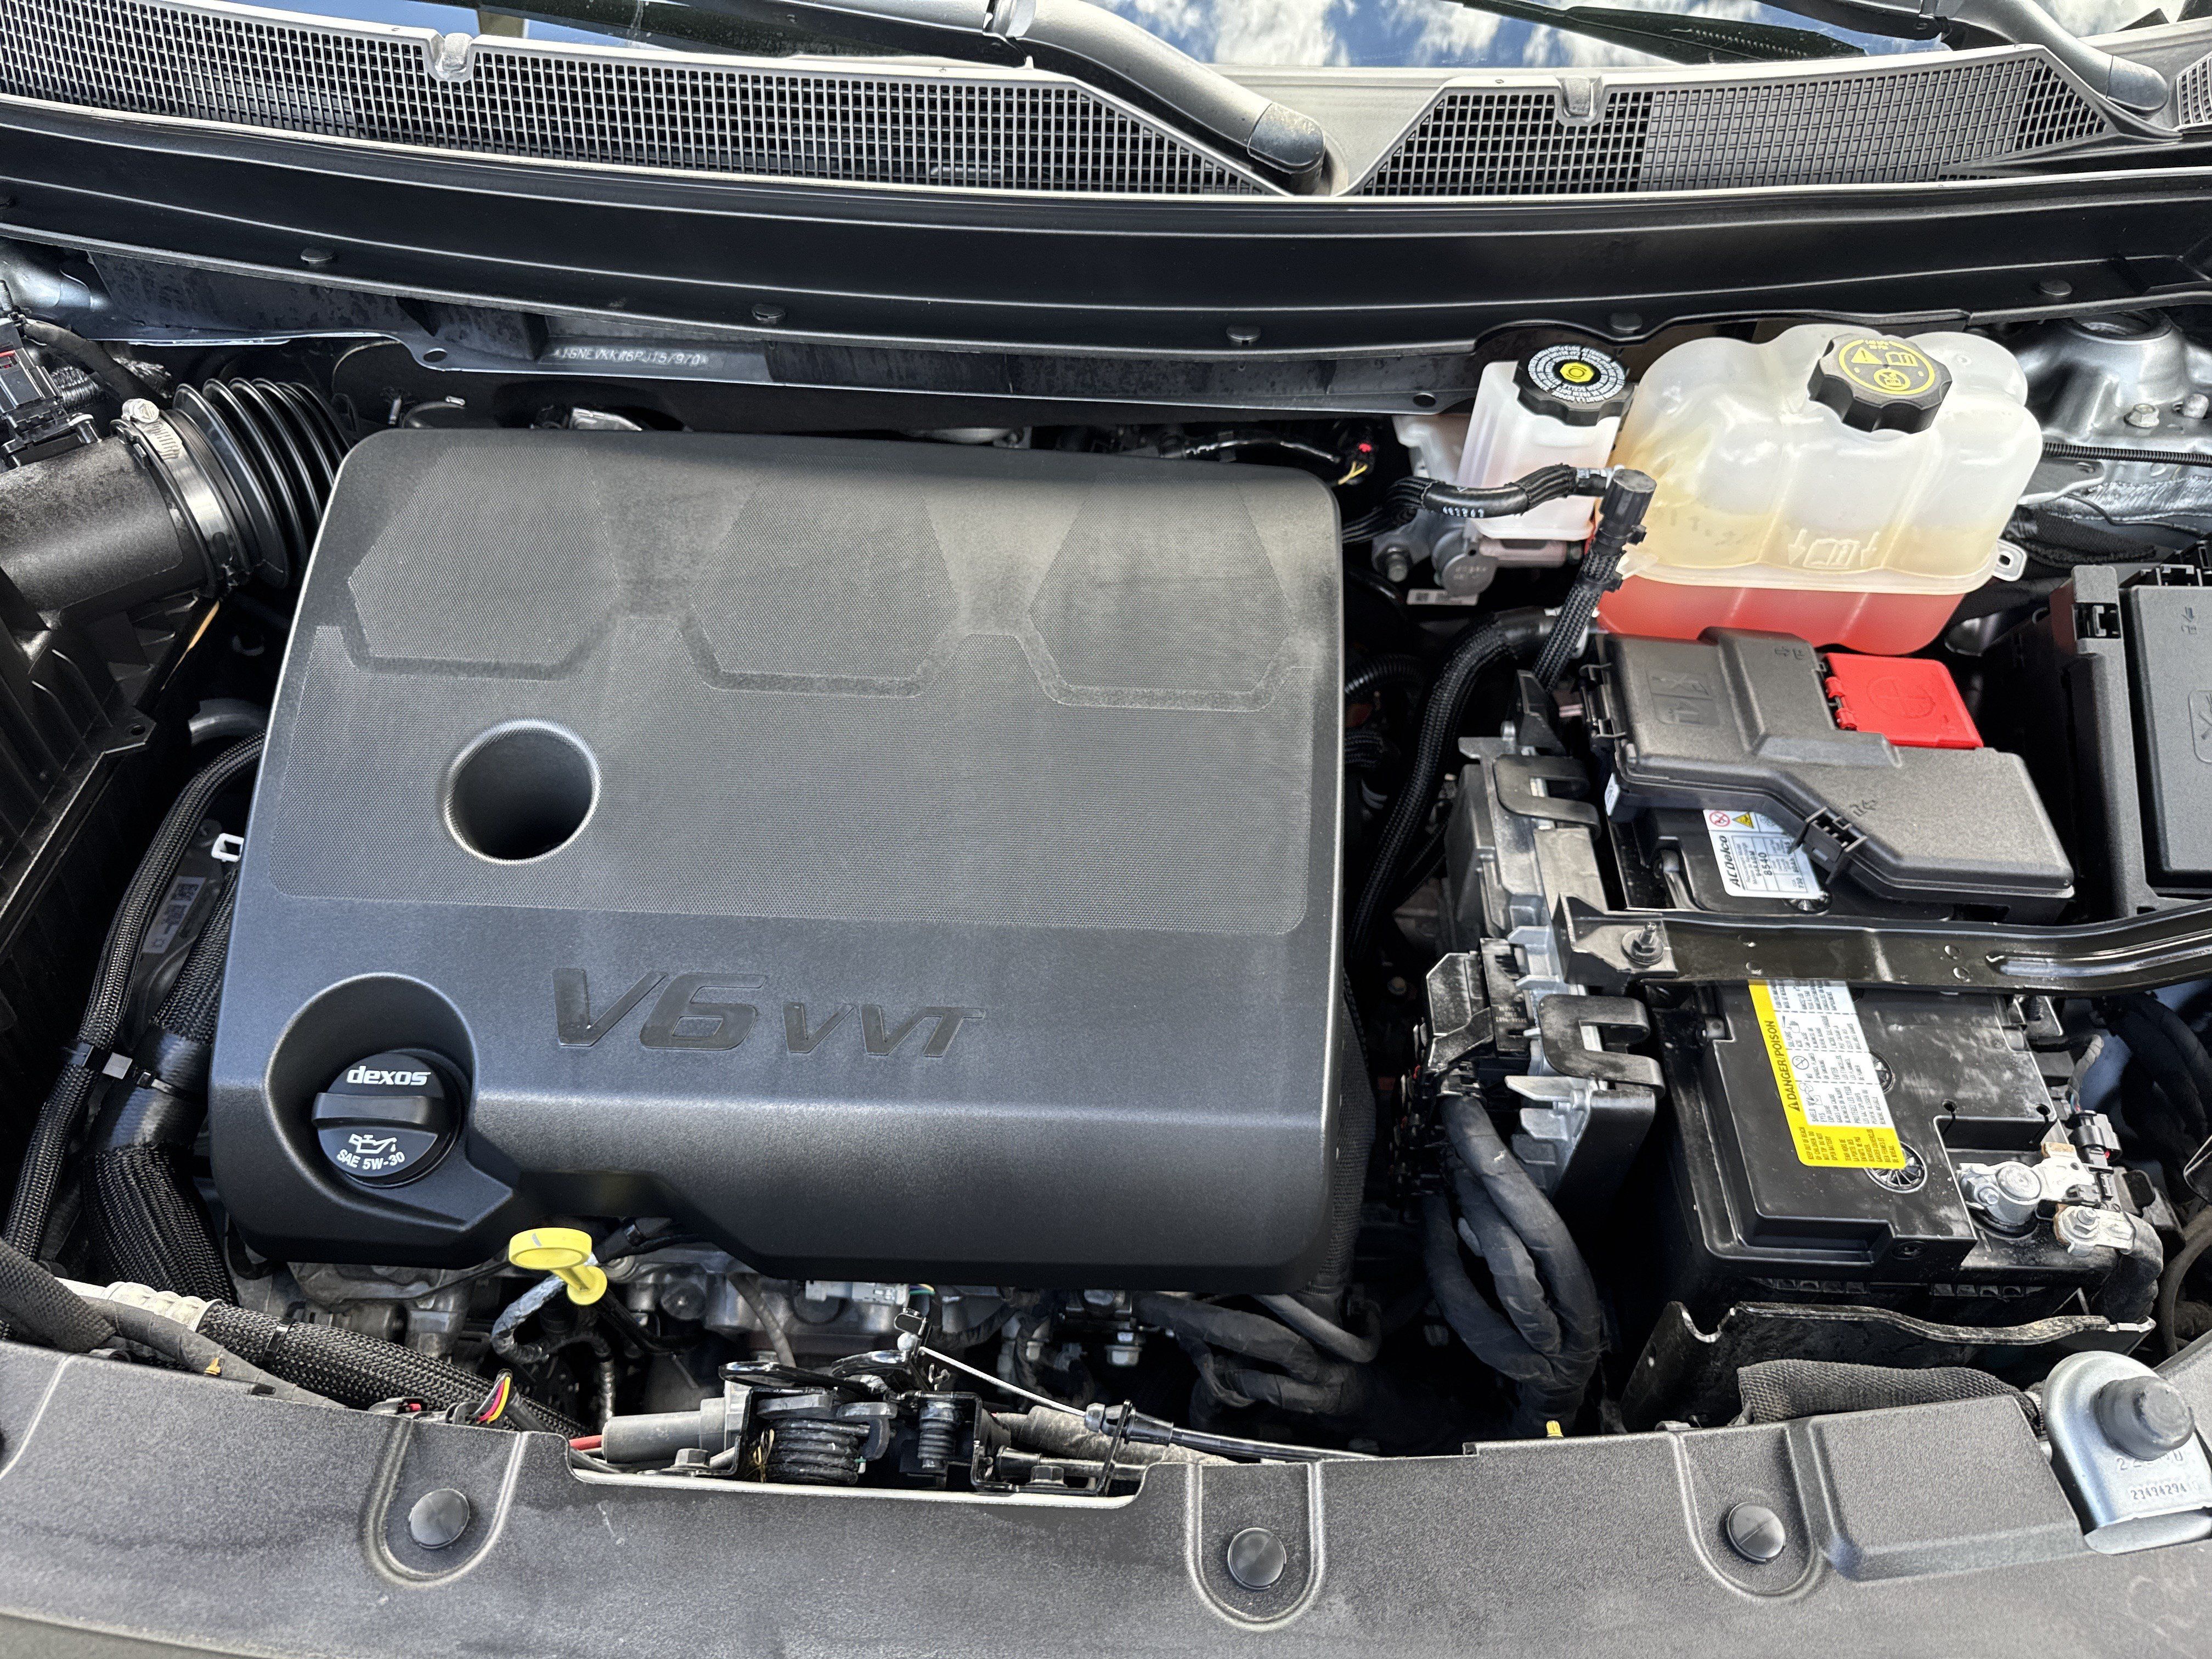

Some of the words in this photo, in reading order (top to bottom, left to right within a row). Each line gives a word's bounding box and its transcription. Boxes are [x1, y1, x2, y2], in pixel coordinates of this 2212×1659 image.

[1718, 835, 1741, 887] ACDelco
[1757, 851, 1773, 876] 8540
[551, 968, 766, 1052] V6
[783, 1002, 986, 1057] VVT
[346, 1065, 431, 1086] dexos
[1764, 1020, 1797, 1099] DANGER/POISON
[336, 1149, 359, 1169] SAE
[362, 1151, 405, 1171] 5W-30
